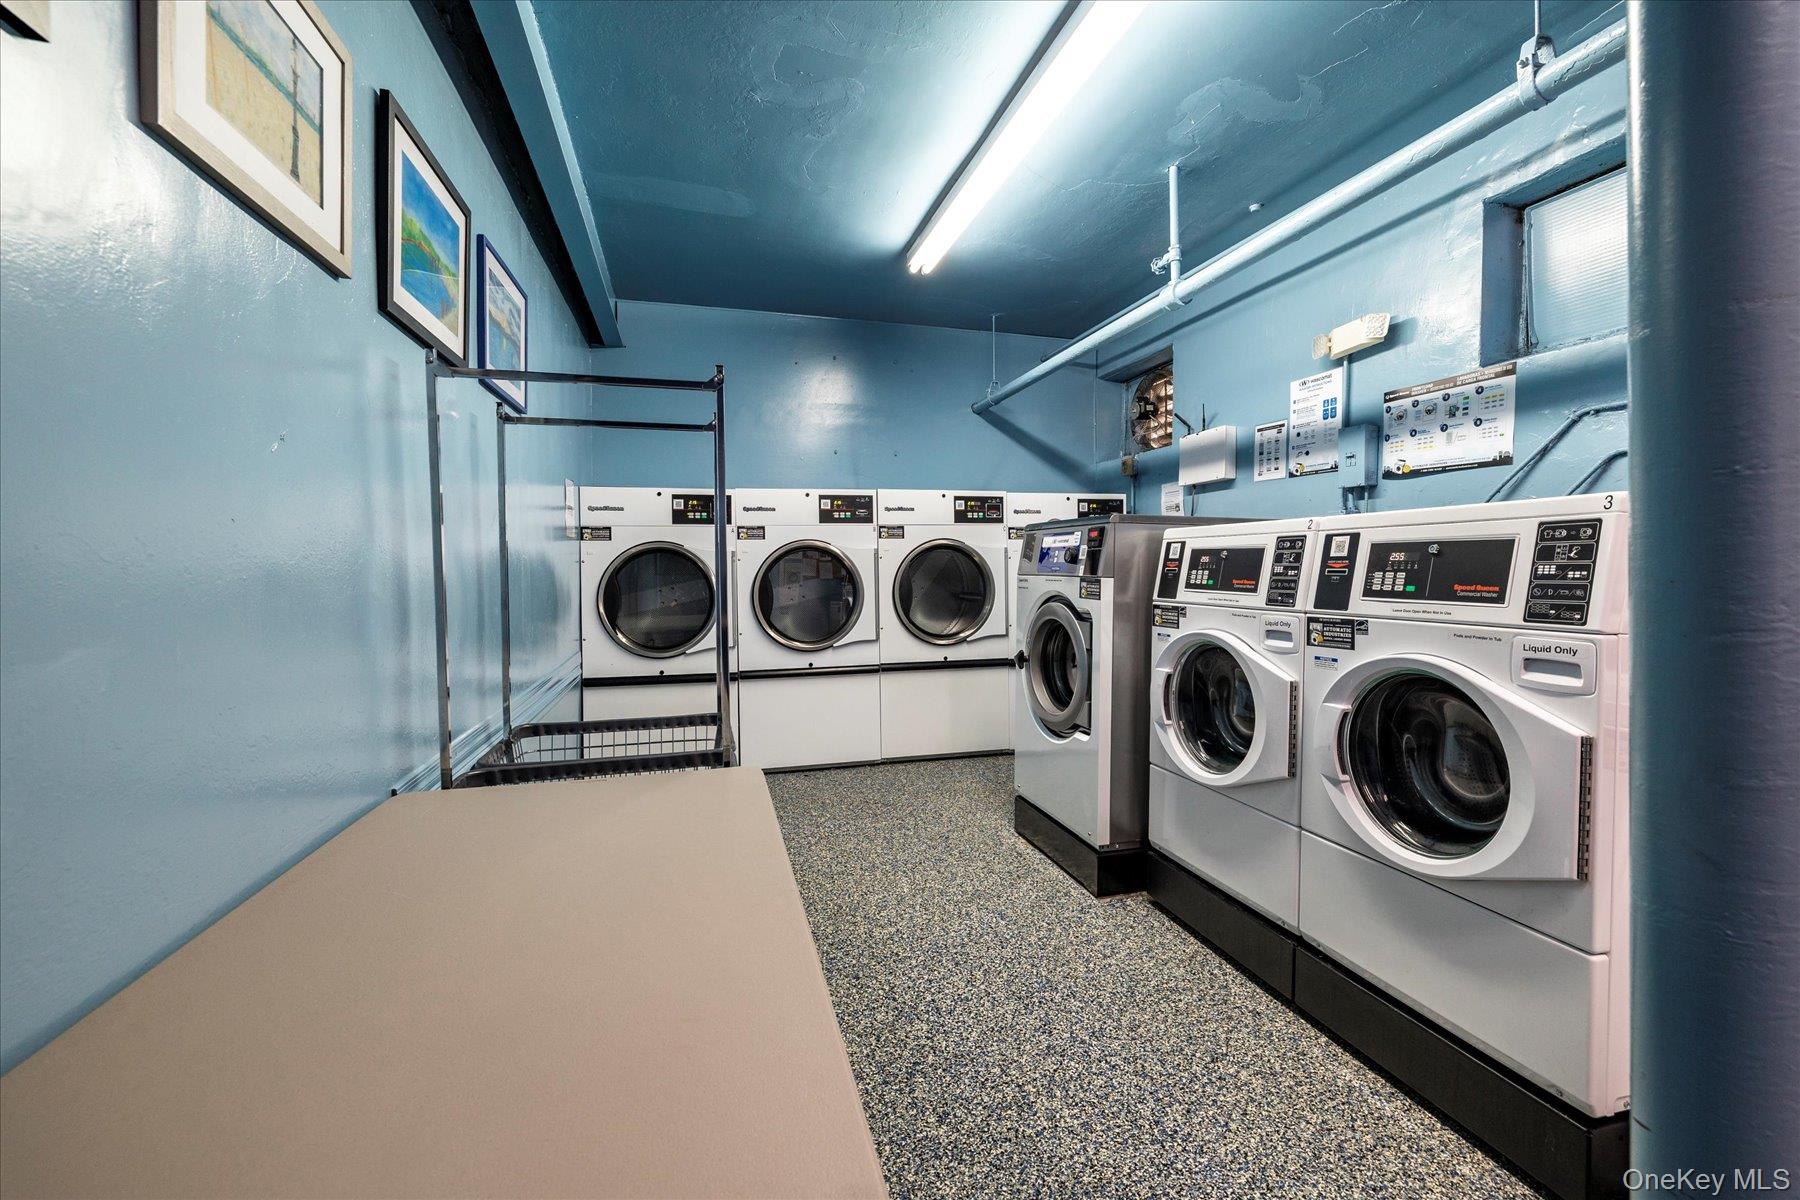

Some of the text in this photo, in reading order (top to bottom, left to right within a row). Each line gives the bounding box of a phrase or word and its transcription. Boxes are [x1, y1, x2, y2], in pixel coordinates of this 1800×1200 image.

[1604, 494, 1613, 510] 3
[1307, 519, 1313, 529] 2
[1476, 584, 1500, 592] Queen
[1265, 620, 1291, 629] Liquid Only
[1523, 644, 1578, 657] Liquid Only
